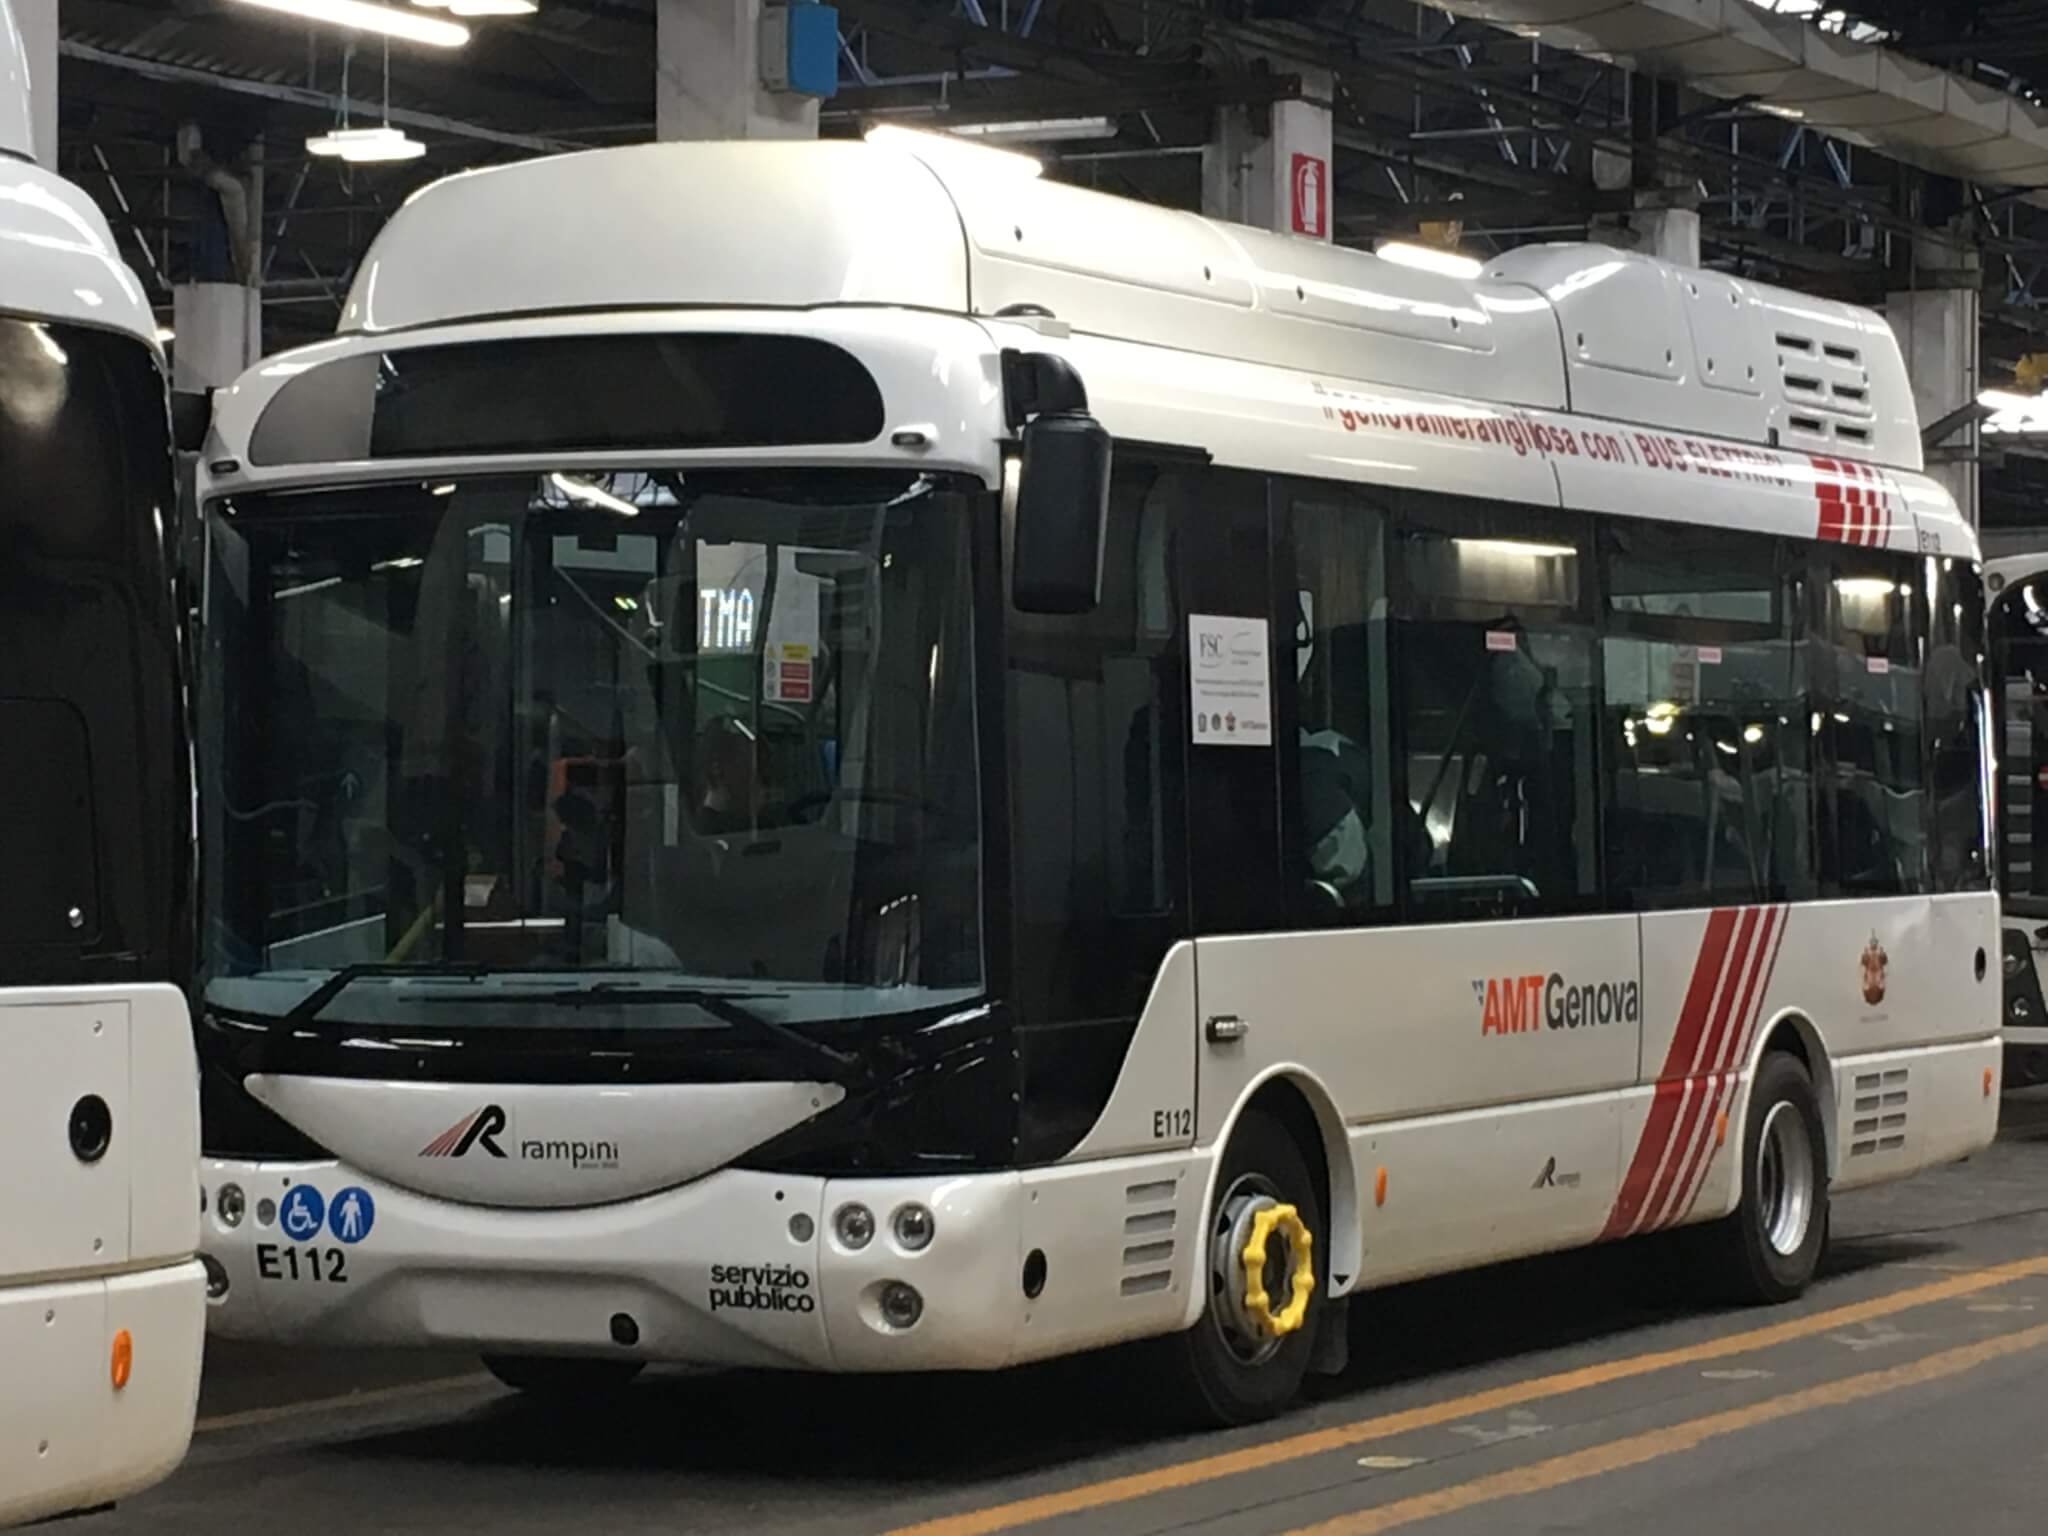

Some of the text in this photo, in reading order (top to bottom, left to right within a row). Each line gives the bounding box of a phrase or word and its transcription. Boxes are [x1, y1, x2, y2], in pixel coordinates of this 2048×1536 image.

[1581, 431, 1626, 464] con
[1634, 433, 1688, 473] BUS
[1154, 1108, 1191, 1138] E112
[521, 1140, 619, 1169] rampini
[257, 1243, 348, 1282] E112
[711, 1262, 810, 1289] servizio
[709, 1285, 815, 1312] pubblico
